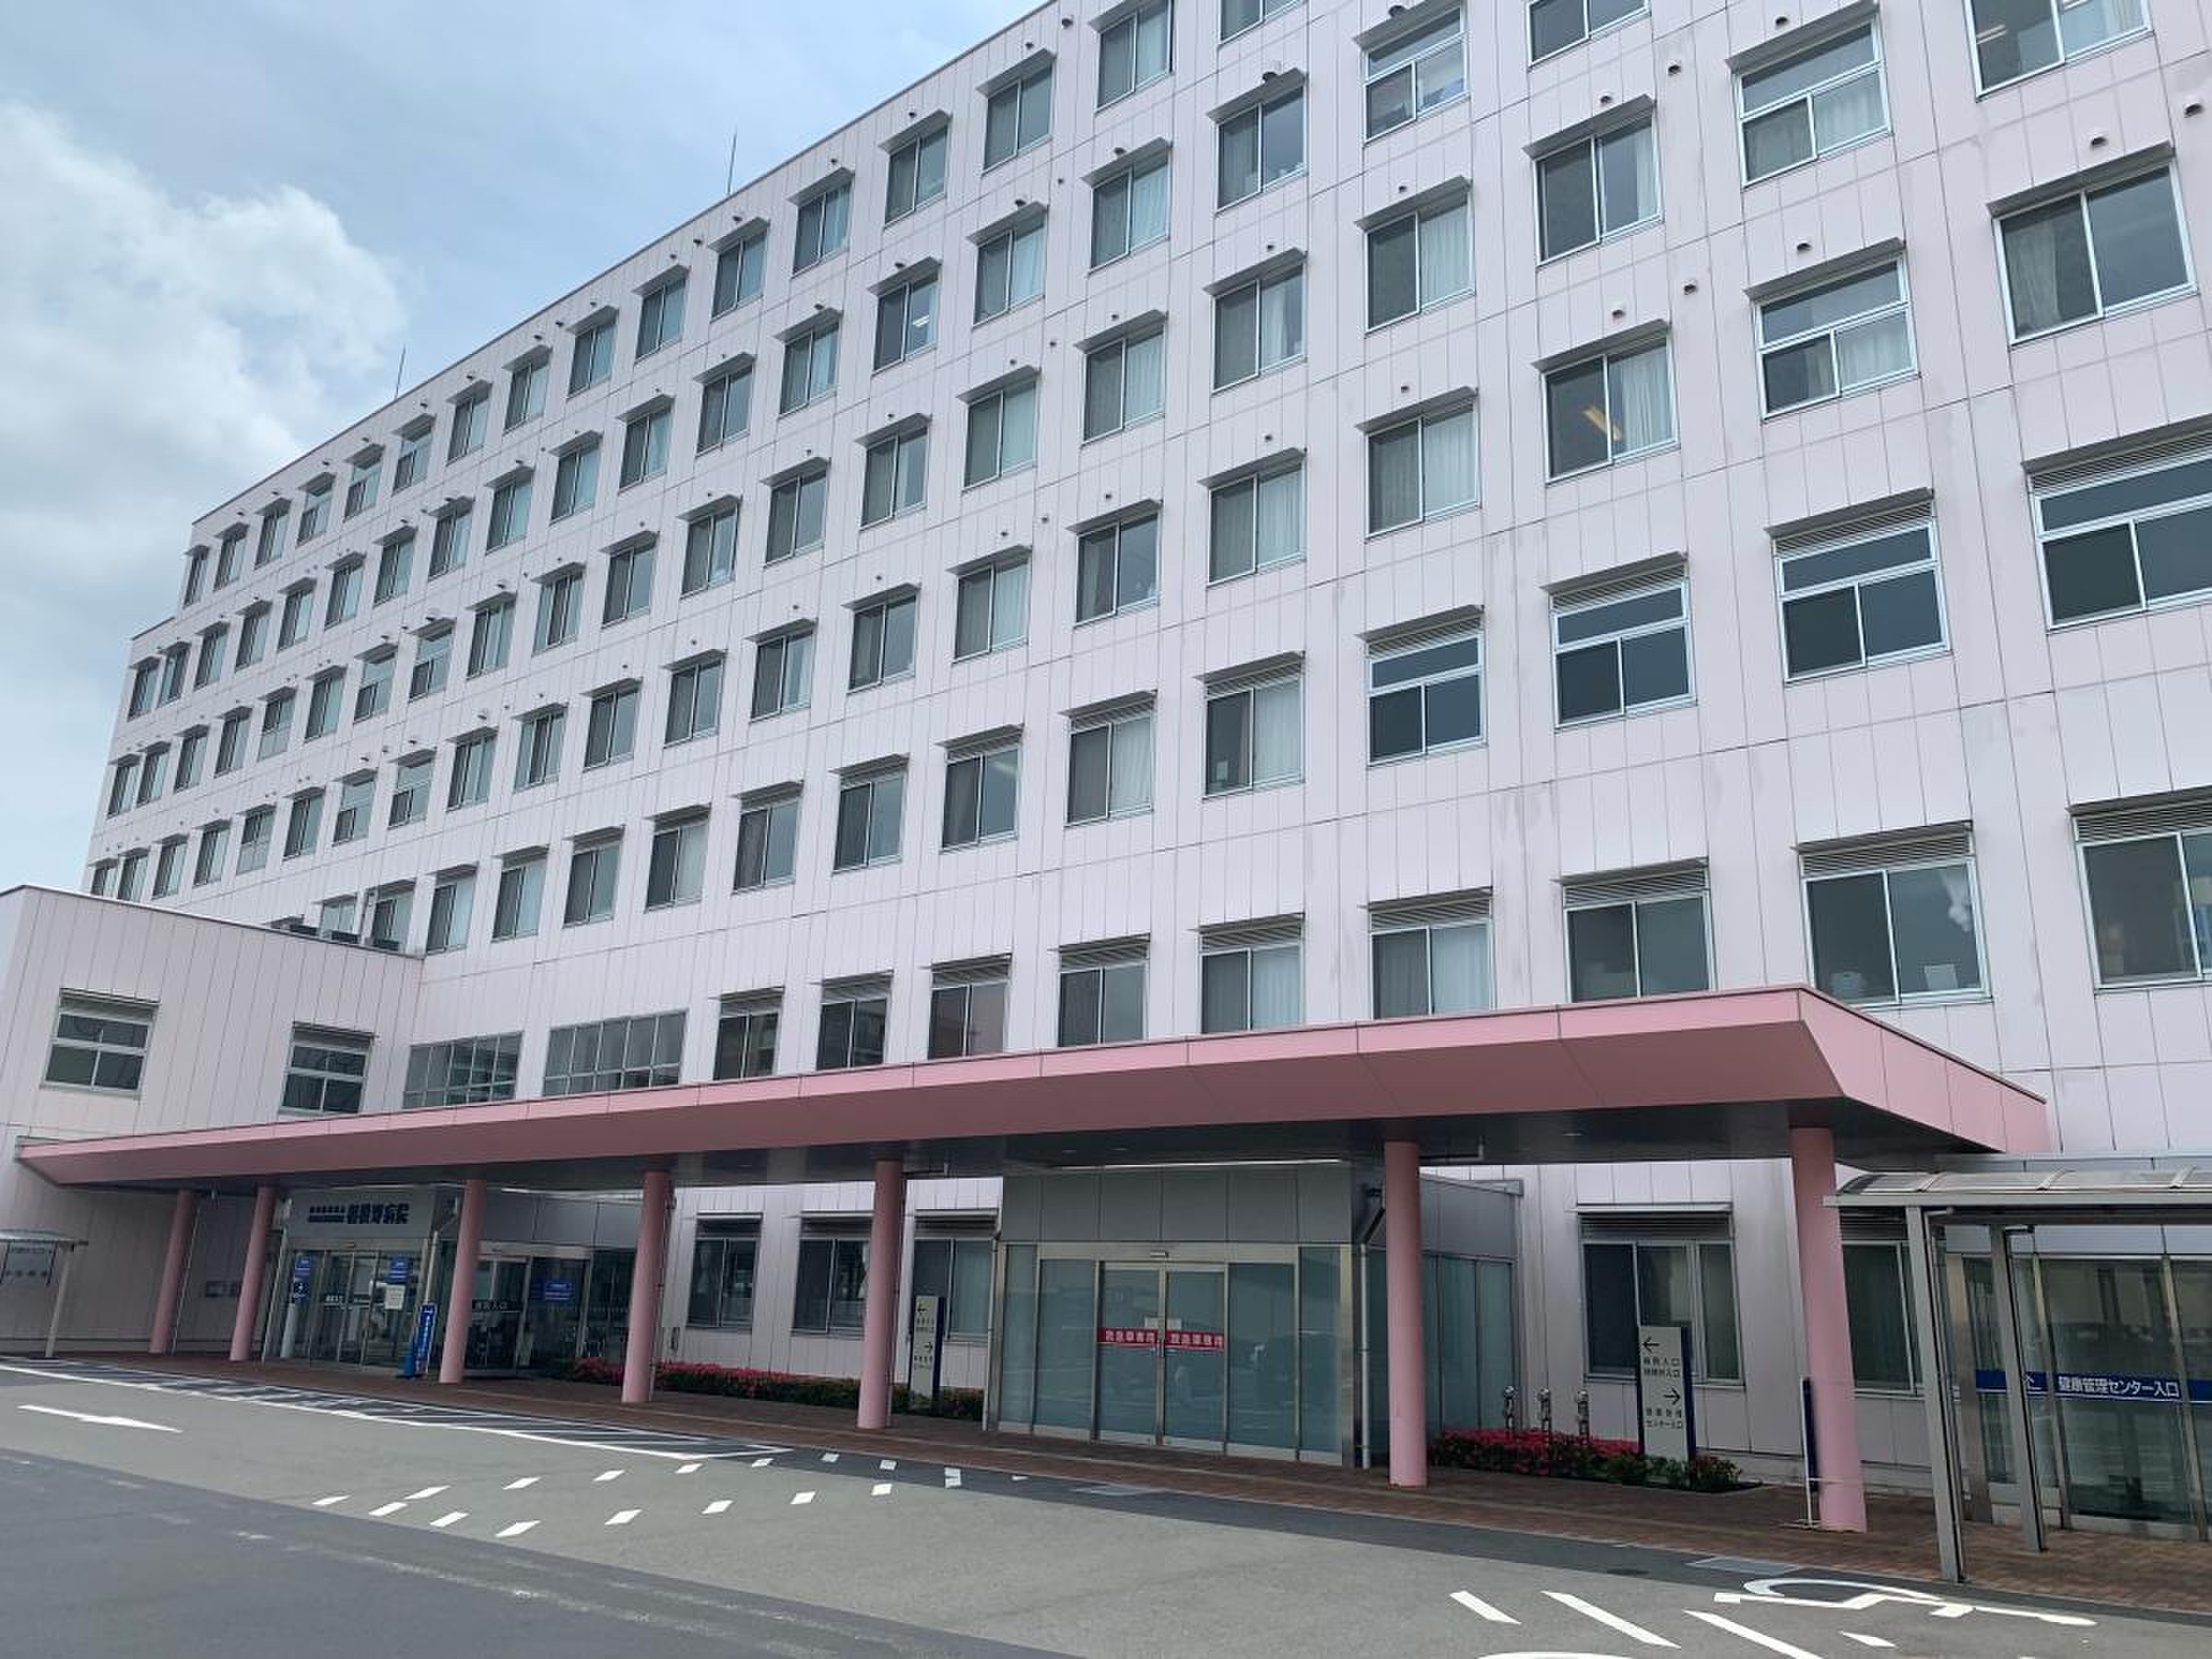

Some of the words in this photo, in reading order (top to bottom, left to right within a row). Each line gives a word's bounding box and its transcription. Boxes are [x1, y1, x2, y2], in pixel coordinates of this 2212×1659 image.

[2058, 1375, 2180, 1397] 健康管理センター入口
